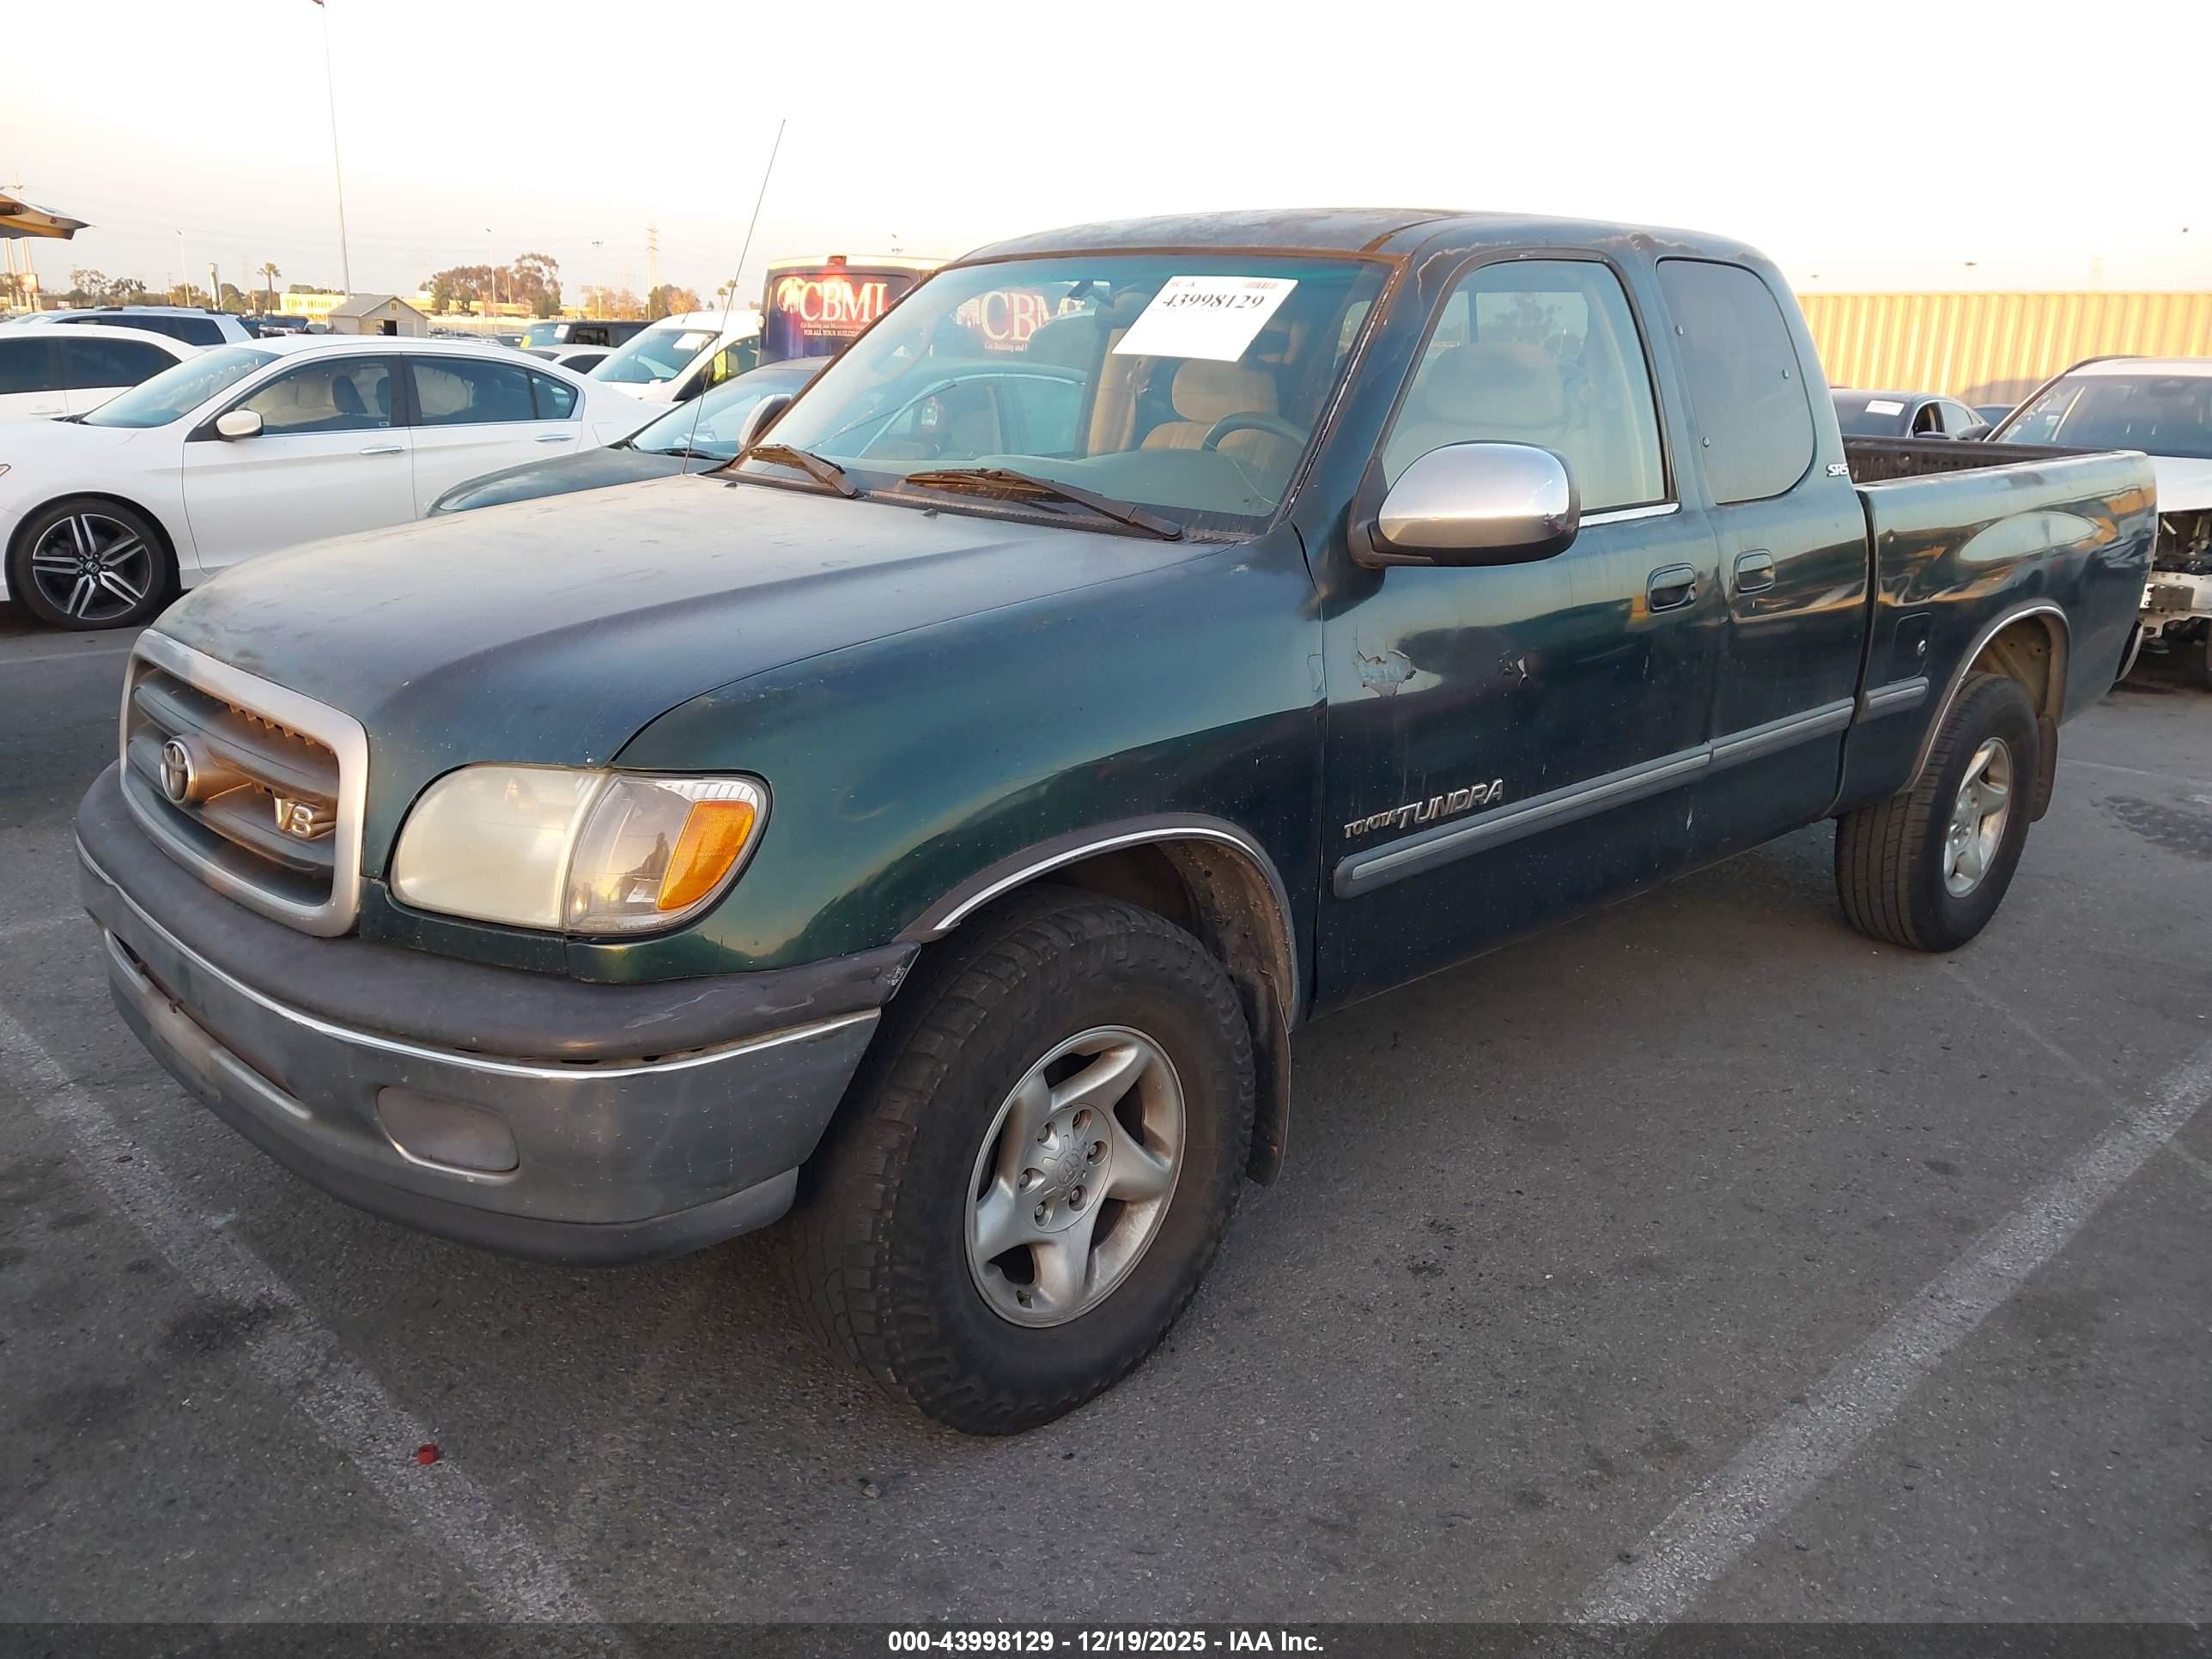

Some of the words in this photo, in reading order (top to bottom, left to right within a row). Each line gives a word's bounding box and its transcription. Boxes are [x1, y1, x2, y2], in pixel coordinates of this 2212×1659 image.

[1163, 294, 1265, 309] 43998129
[822, 329, 836, 337] YOUR
[1826, 464, 1850, 477] SR5
[1344, 810, 1397, 838] TOYOTA
[1398, 778, 1503, 830] TUNDRA
[275, 797, 314, 839] V8
